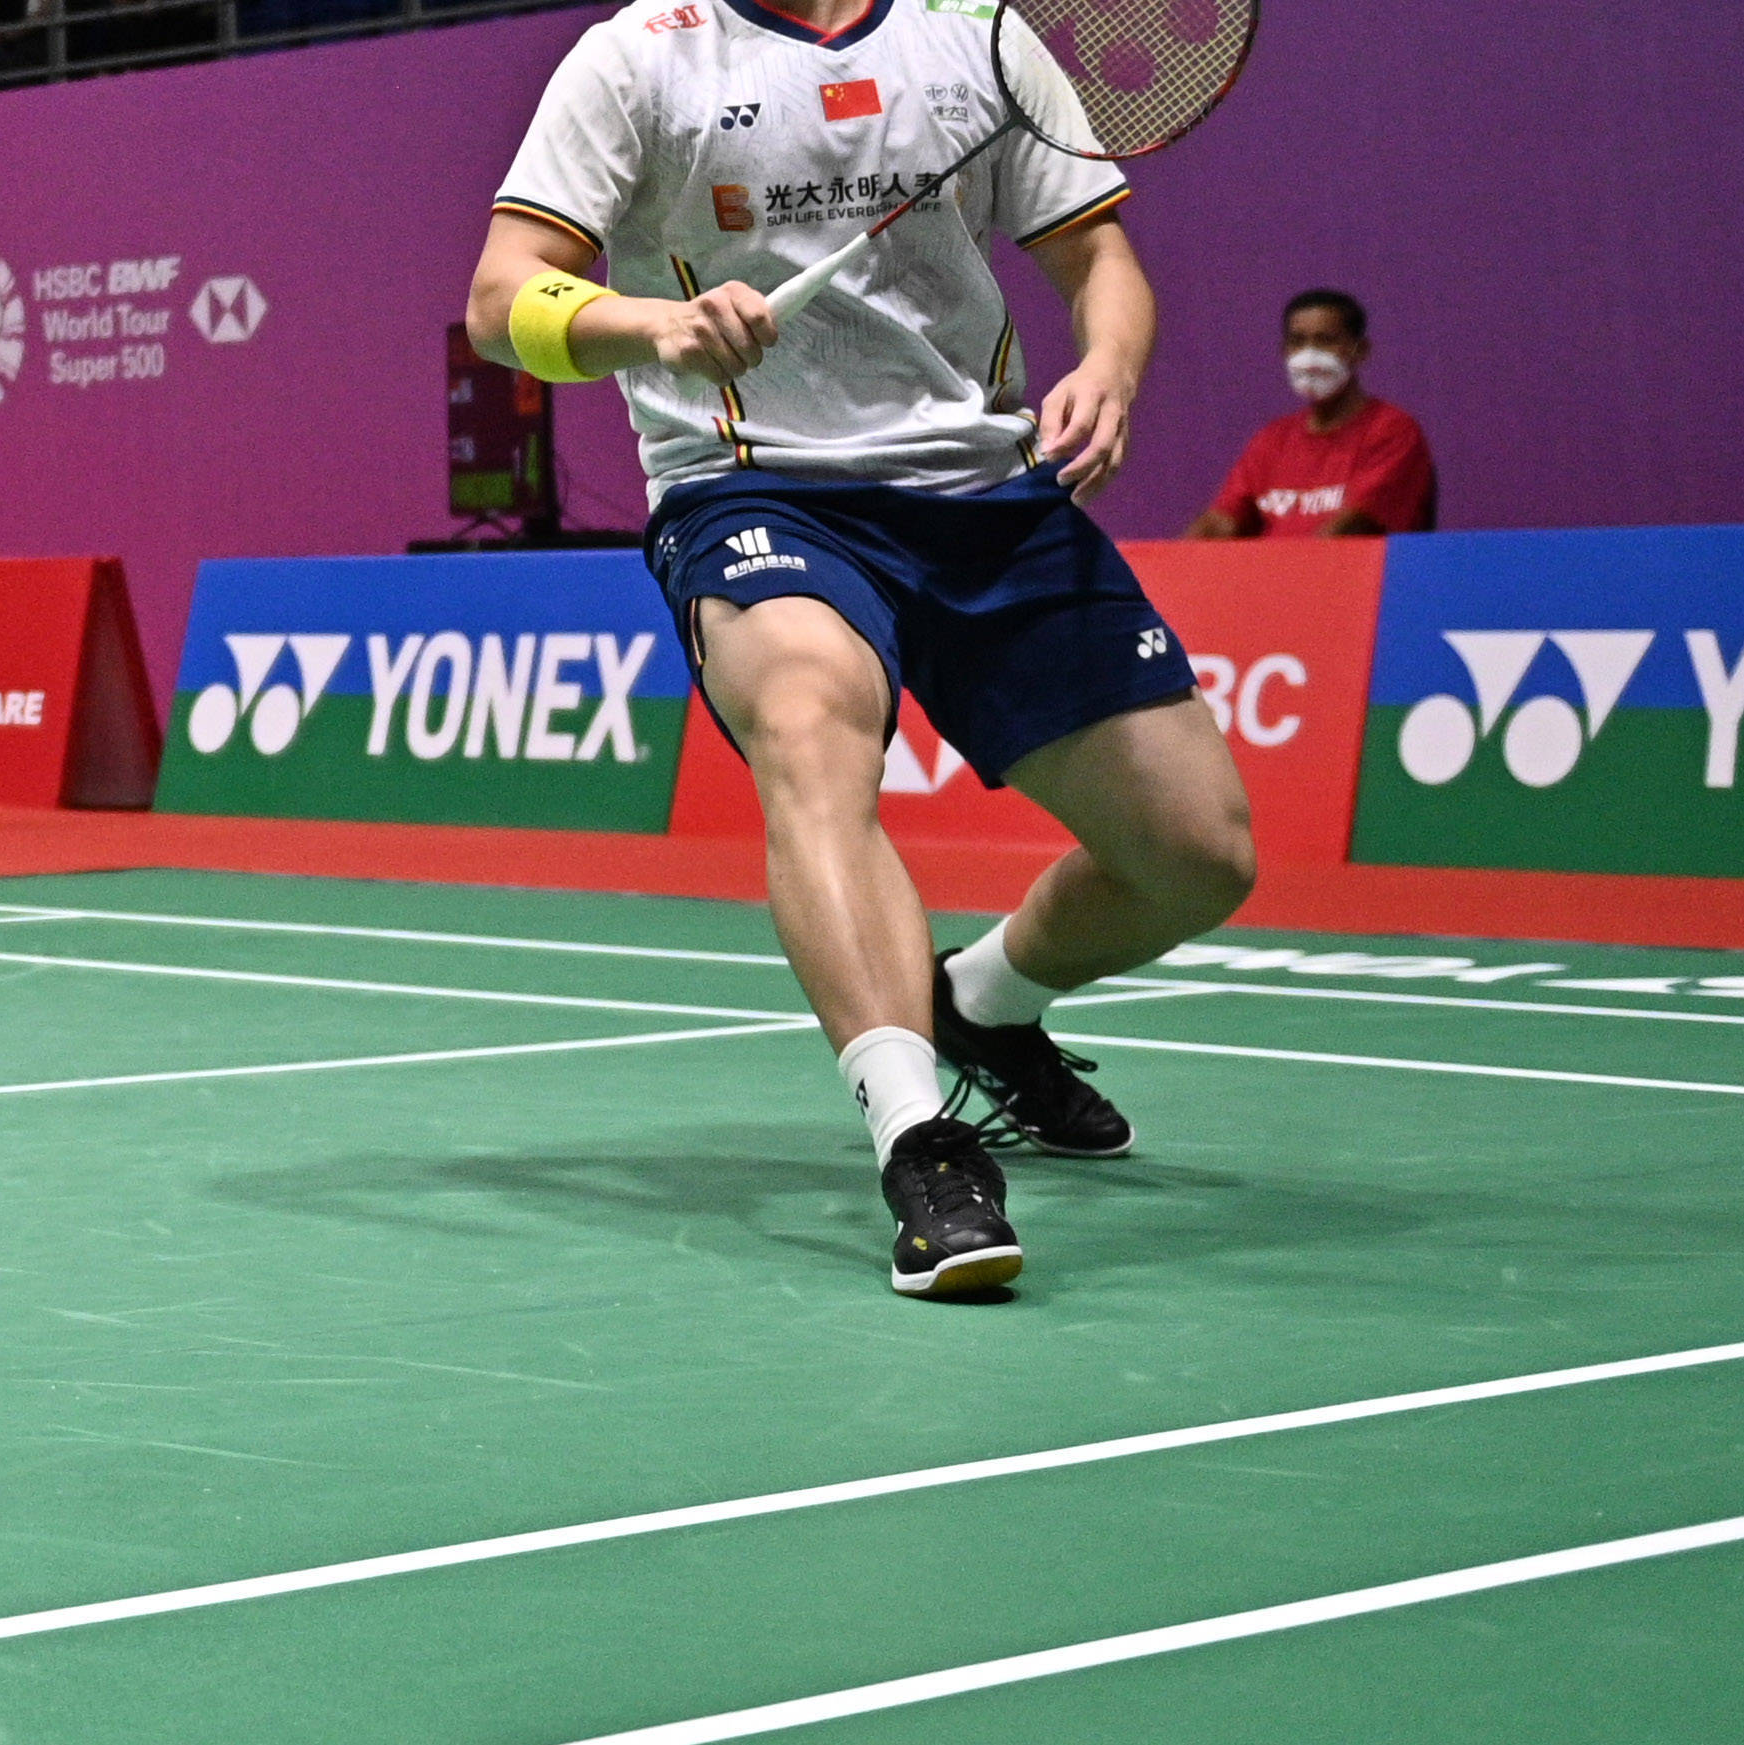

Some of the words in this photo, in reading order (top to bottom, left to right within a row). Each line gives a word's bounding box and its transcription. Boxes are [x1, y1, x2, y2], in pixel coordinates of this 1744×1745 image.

[767, 213, 792, 228] SUN
[795, 210, 824, 224] LIFE
[33, 264, 102, 300] HSBC
[109, 256, 182, 295] BWF
[42, 307, 113, 342] World
[117, 303, 171, 337] Tour
[50, 350, 118, 388] Super
[121, 342, 166, 379] 500
[366, 631, 657, 762] YONEX
